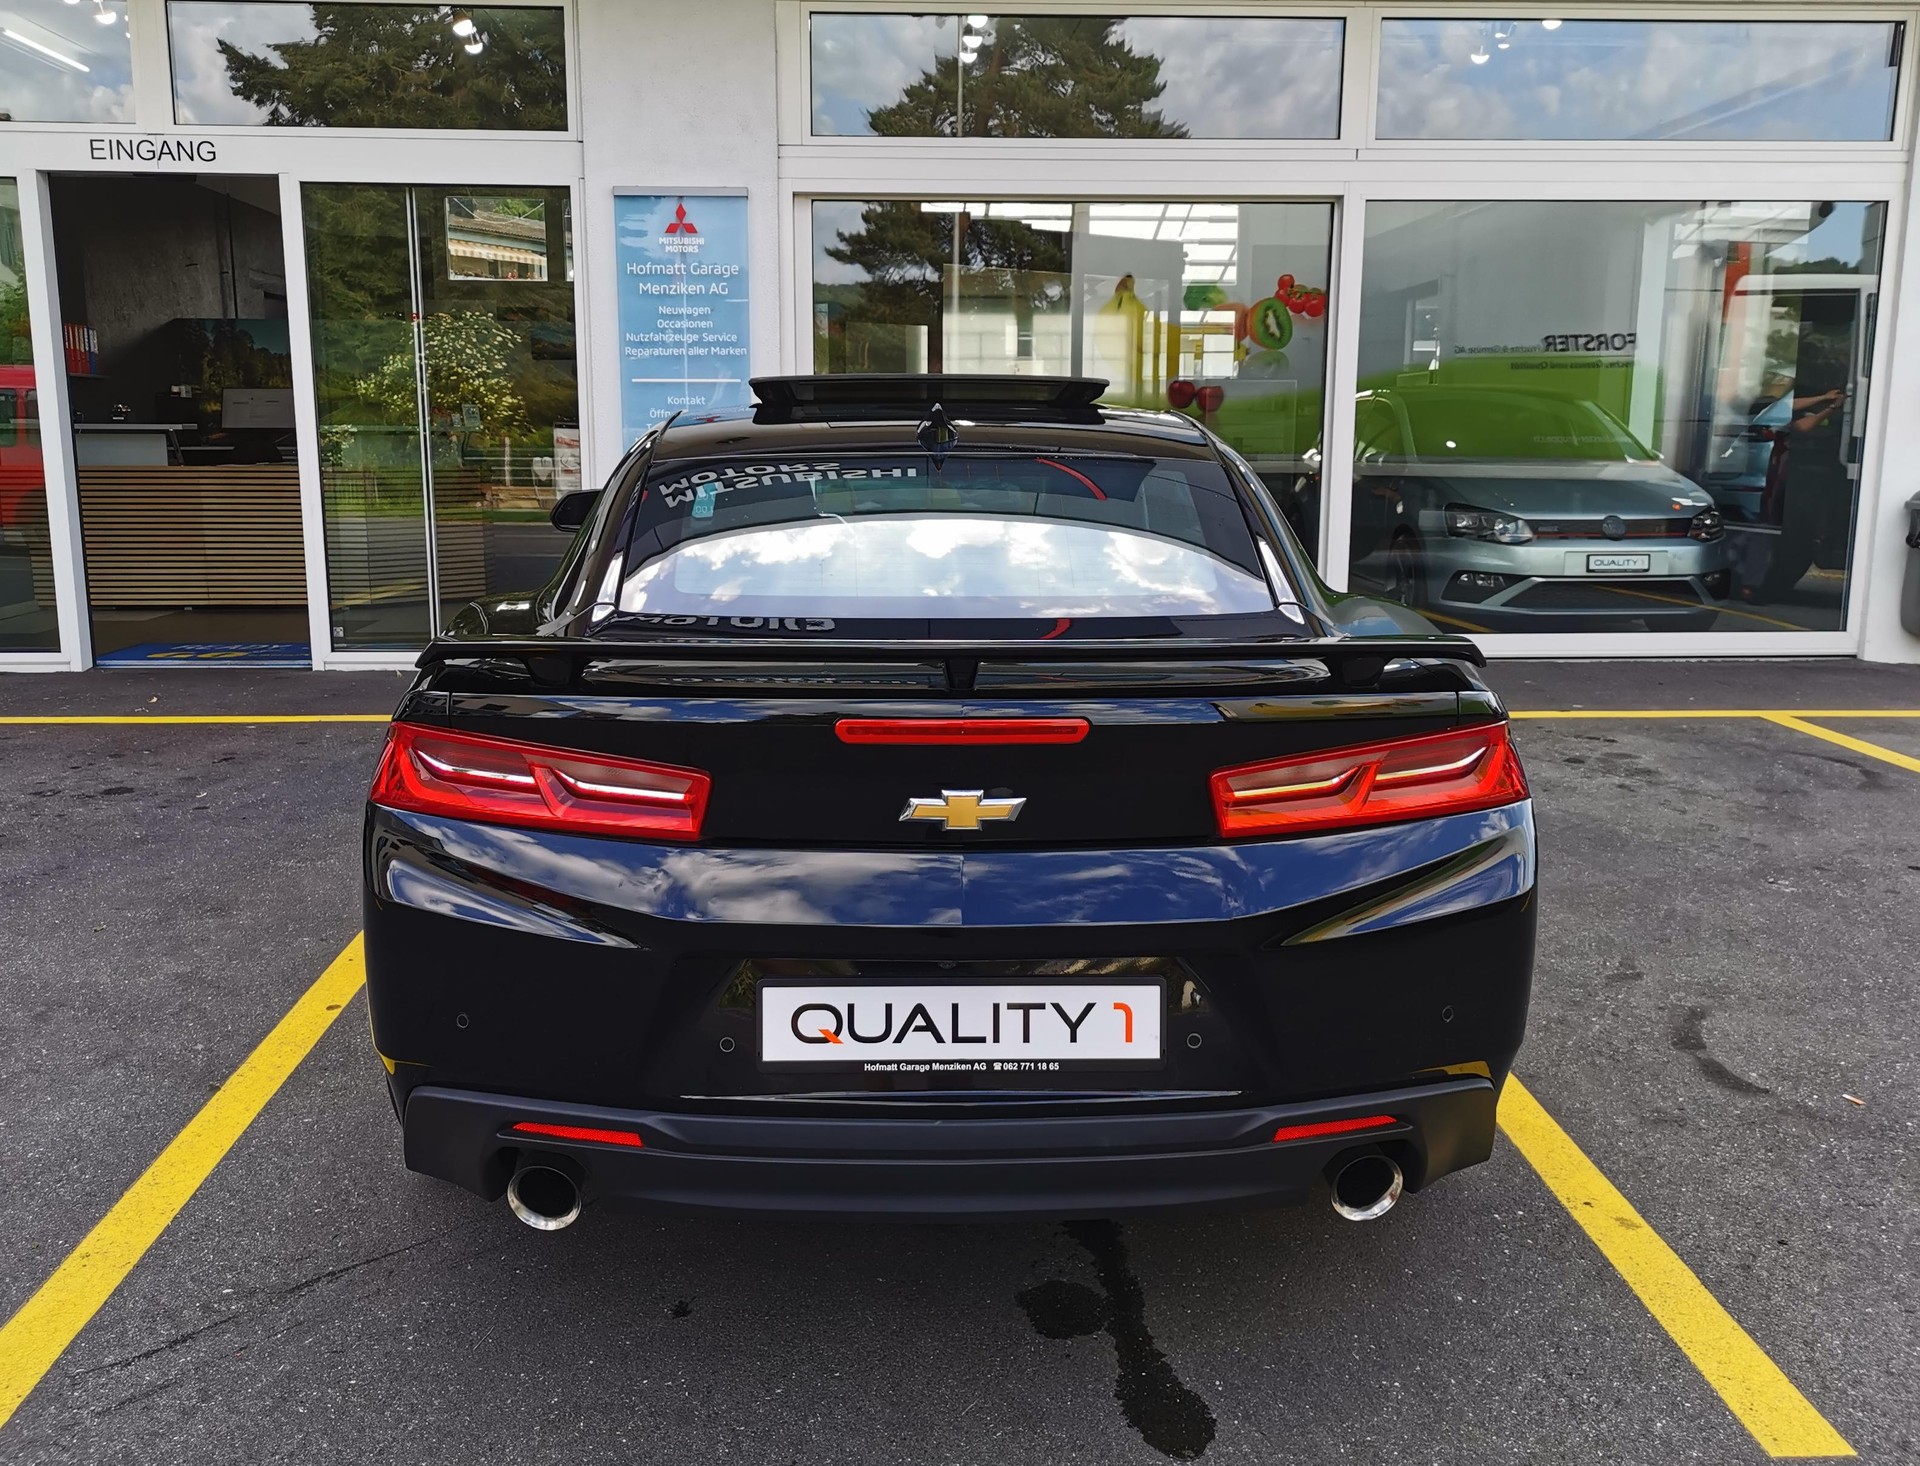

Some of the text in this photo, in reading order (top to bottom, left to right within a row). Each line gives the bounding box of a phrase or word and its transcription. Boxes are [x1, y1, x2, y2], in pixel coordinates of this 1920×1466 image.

[89, 138, 217, 162] EINGANG
[658, 236, 705, 246] MITSUBISHI
[664, 245, 699, 253] MOTORS
[626, 262, 740, 278] Hofmatt Garage
[639, 282, 729, 295] Menziken AG
[658, 306, 711, 317] Neuwagen
[656, 319, 714, 329] Occasionen
[626, 332, 738, 344] Nutzfahrzeuge Service
[624, 346, 748, 357] Reparaturen aller Marken
[667, 396, 707, 406] Kontakt
[1593, 559, 1638, 567] QUALITY
[790, 1002, 1134, 1045] QUALITY 1
[864, 1062, 1060, 1073] Hofmatt Garage Menziken AG 062 771 18 65
